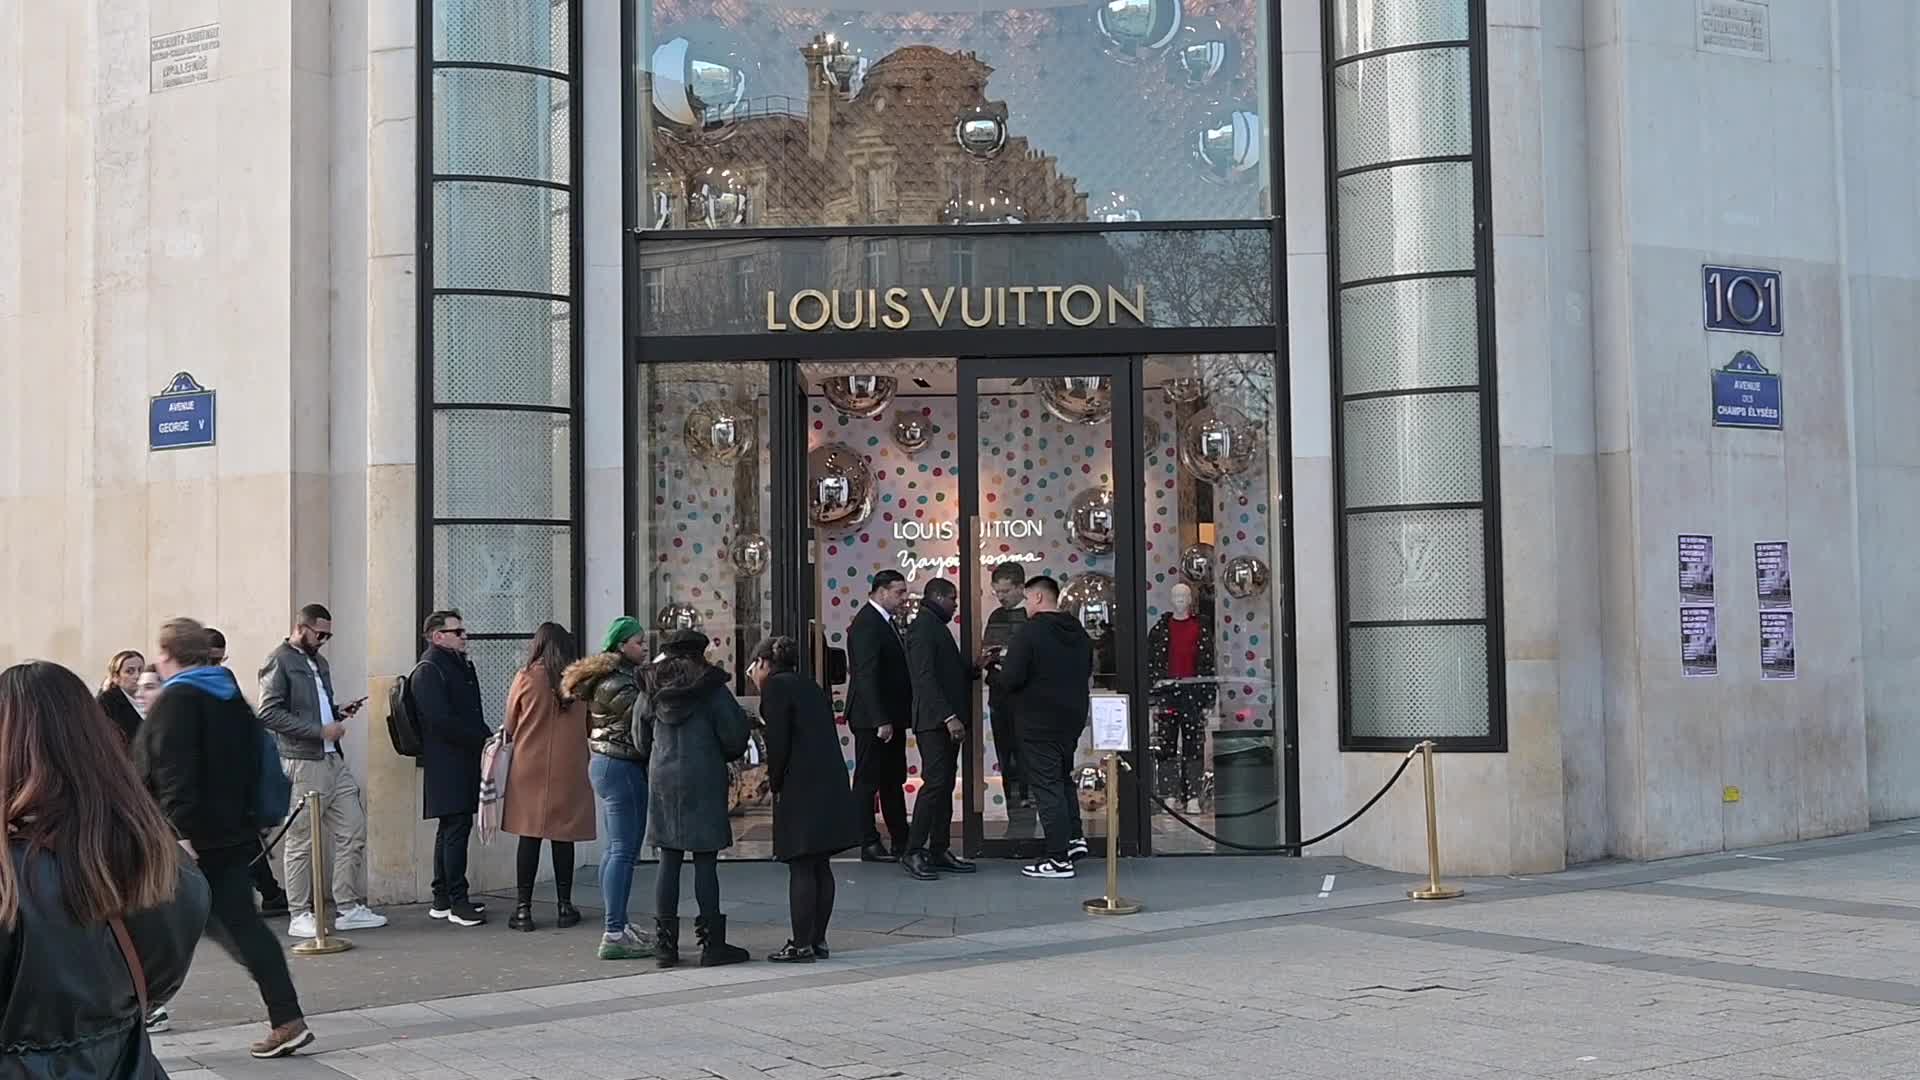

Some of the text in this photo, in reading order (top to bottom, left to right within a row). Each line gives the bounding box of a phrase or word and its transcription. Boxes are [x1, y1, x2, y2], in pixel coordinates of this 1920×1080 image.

[1708, 272, 1777, 327] 101
[767, 284, 1146, 331] LOUIS VUITTON
[1734, 380, 1761, 391] AVENUE
[168, 400, 195, 412] AVENUE
[1717, 405, 1747, 417] CHAMPS
[158, 418, 205, 433] GEORGE V
[893, 519, 1042, 540] LOUIS ITTON
